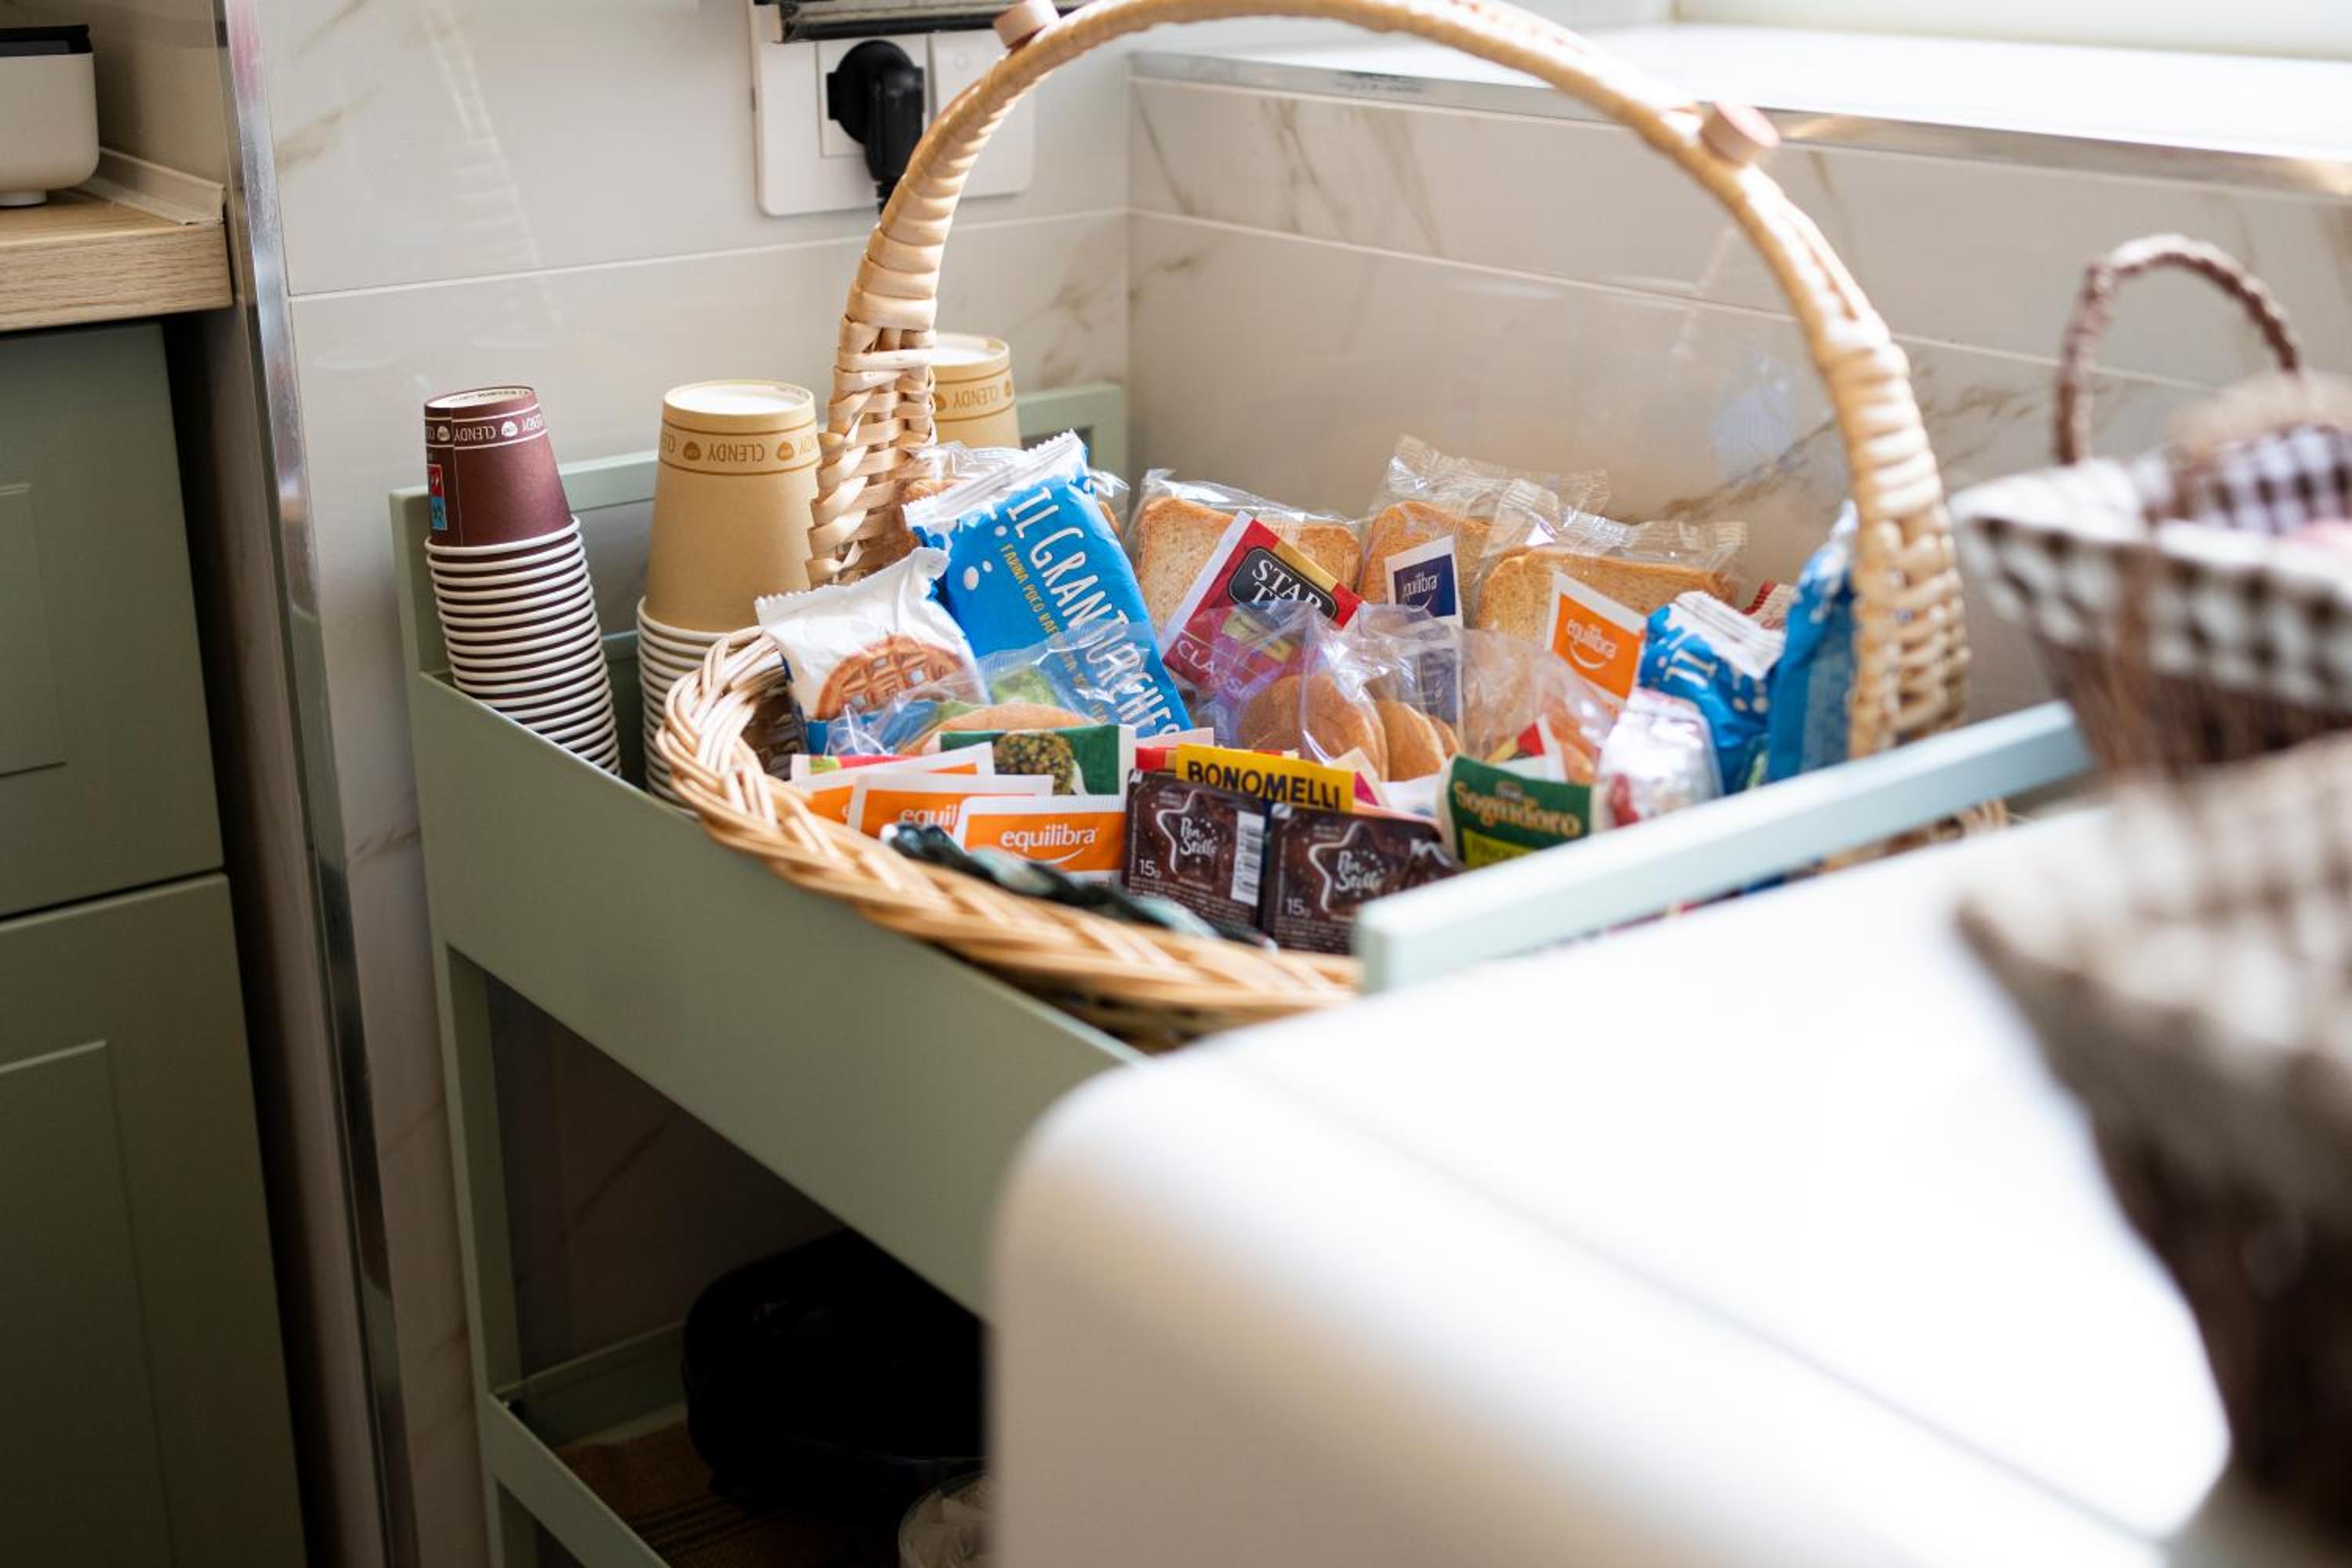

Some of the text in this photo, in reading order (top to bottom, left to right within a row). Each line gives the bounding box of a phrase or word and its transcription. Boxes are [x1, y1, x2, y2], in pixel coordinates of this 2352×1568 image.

[453, 426, 497, 443] CLENDY
[707, 443, 765, 463] CLENDY
[1007, 487, 1059, 539] IL
[1187, 760, 1341, 811] BONOMELLI
[1000, 823, 1097, 853] equilibra
